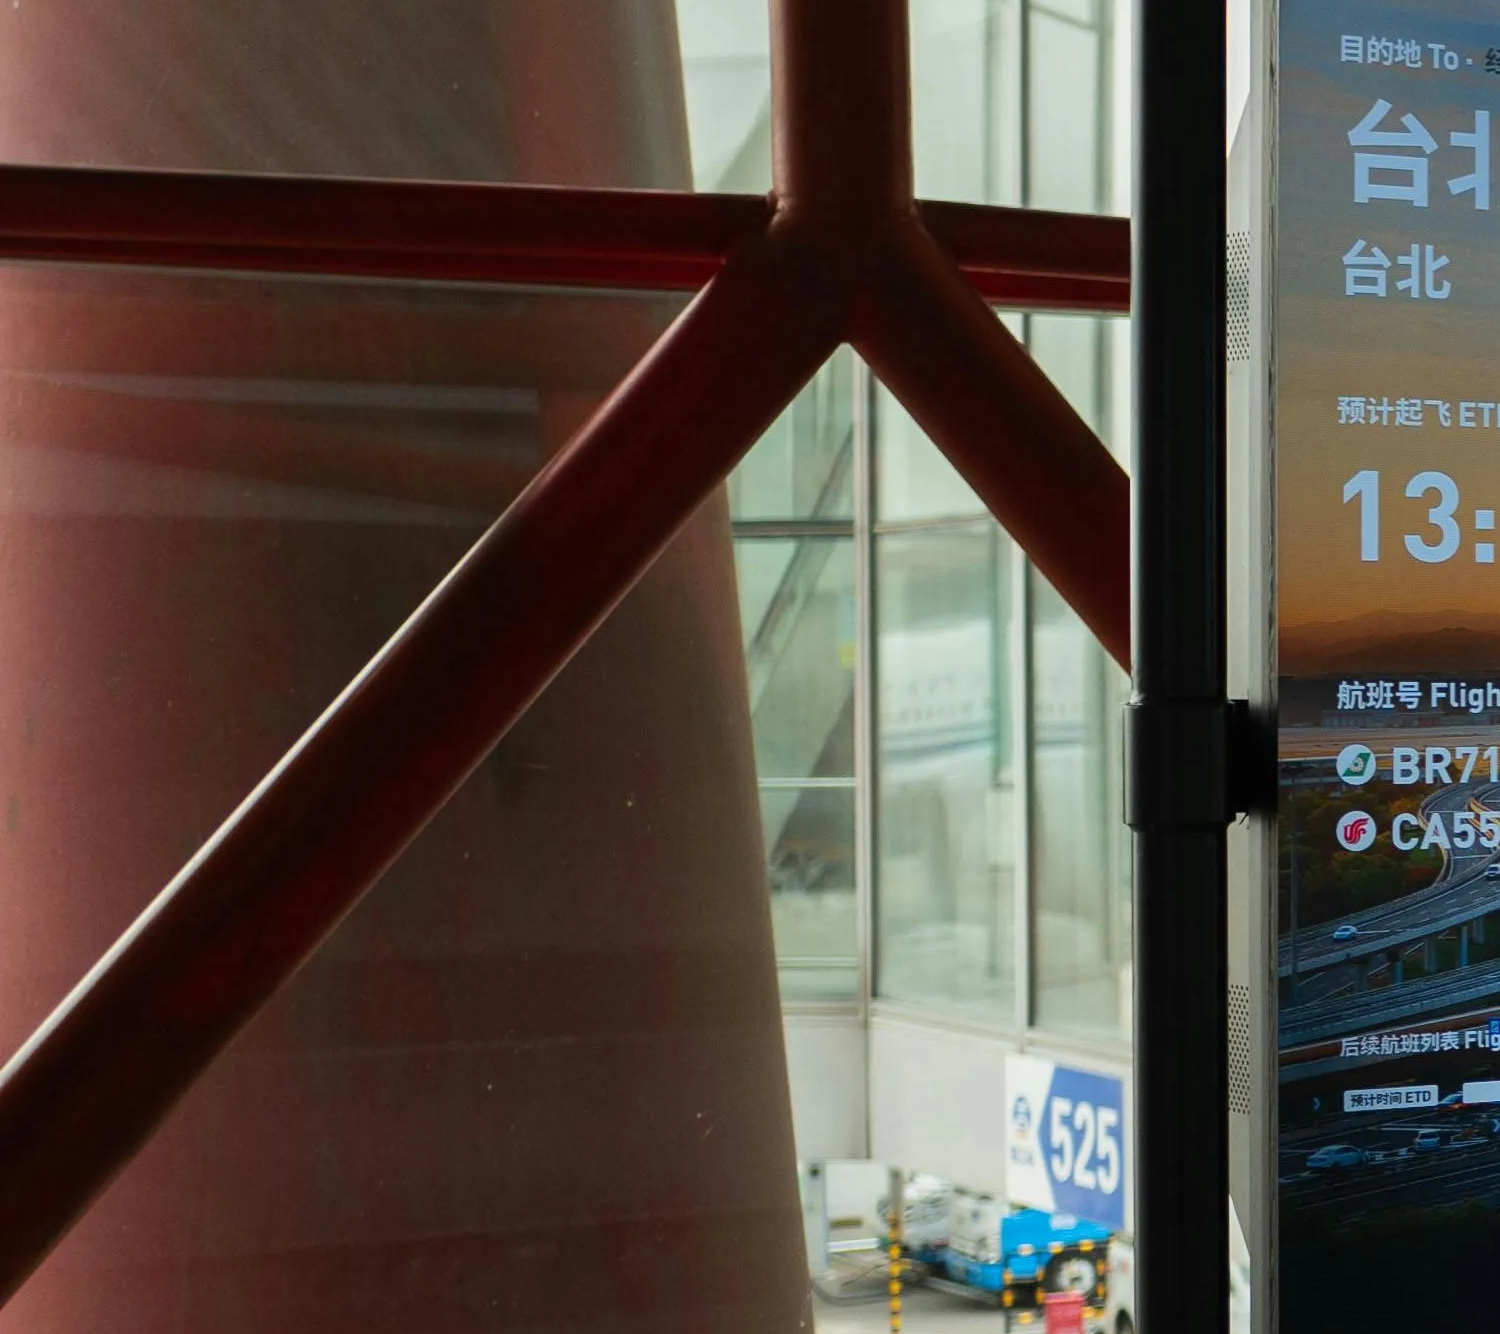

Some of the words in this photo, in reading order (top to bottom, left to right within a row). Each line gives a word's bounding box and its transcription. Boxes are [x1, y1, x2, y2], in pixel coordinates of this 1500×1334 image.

[1340, 34, 1422, 67] 目的地
[1342, 238, 1451, 299] 台北
[1337, 396, 1451, 428] 预计起飞
[1336, 680, 1422, 710] 航班号
[1340, 1031, 1460, 1058] 后续航班列表
[1350, 1091, 1402, 1108] 预计时间
[1405, 1090, 1431, 1104] ETD
[1050, 1096, 1120, 1195] 525
